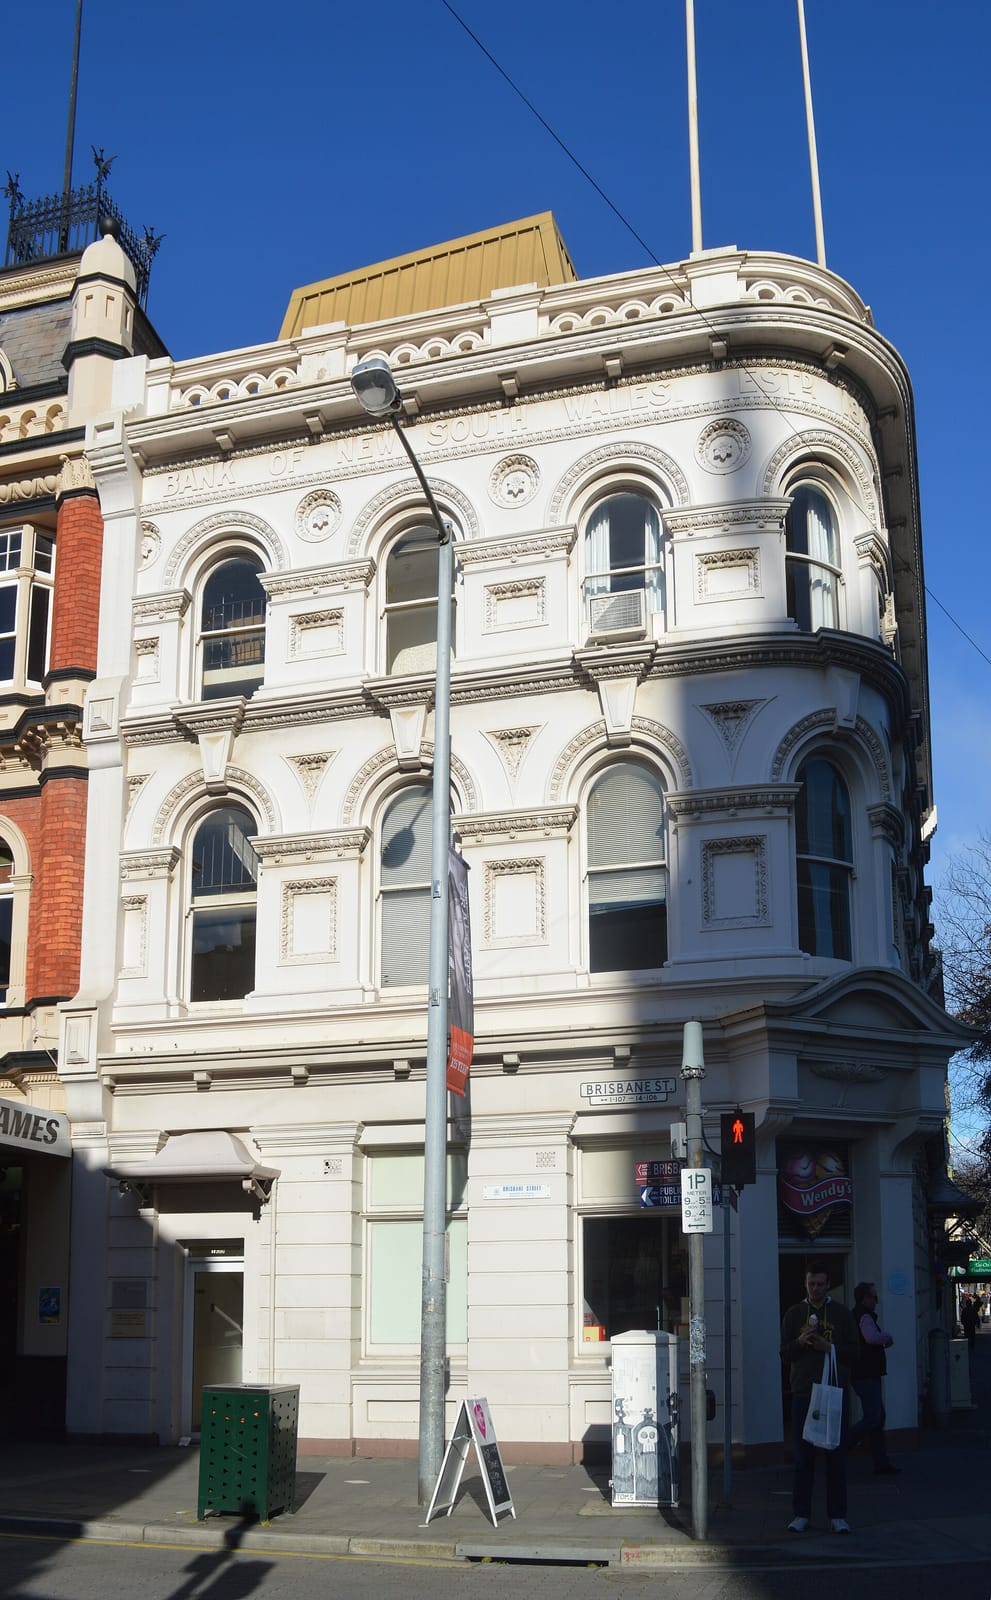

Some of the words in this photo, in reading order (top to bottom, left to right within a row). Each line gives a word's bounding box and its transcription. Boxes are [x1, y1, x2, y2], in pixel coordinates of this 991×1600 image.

[163, 460, 236, 498] BANK
[269, 450, 305, 476] OF
[336, 430, 398, 464] NEW
[427, 406, 528, 446] SOUTH
[586, 1082, 652, 1095] BRISBANE
[655, 1080, 673, 1091] ST.
[0, 1106, 60, 1145] AMES
[687, 1173, 706, 1189] 1P
[801, 1181, 853, 1207] Wendy's
